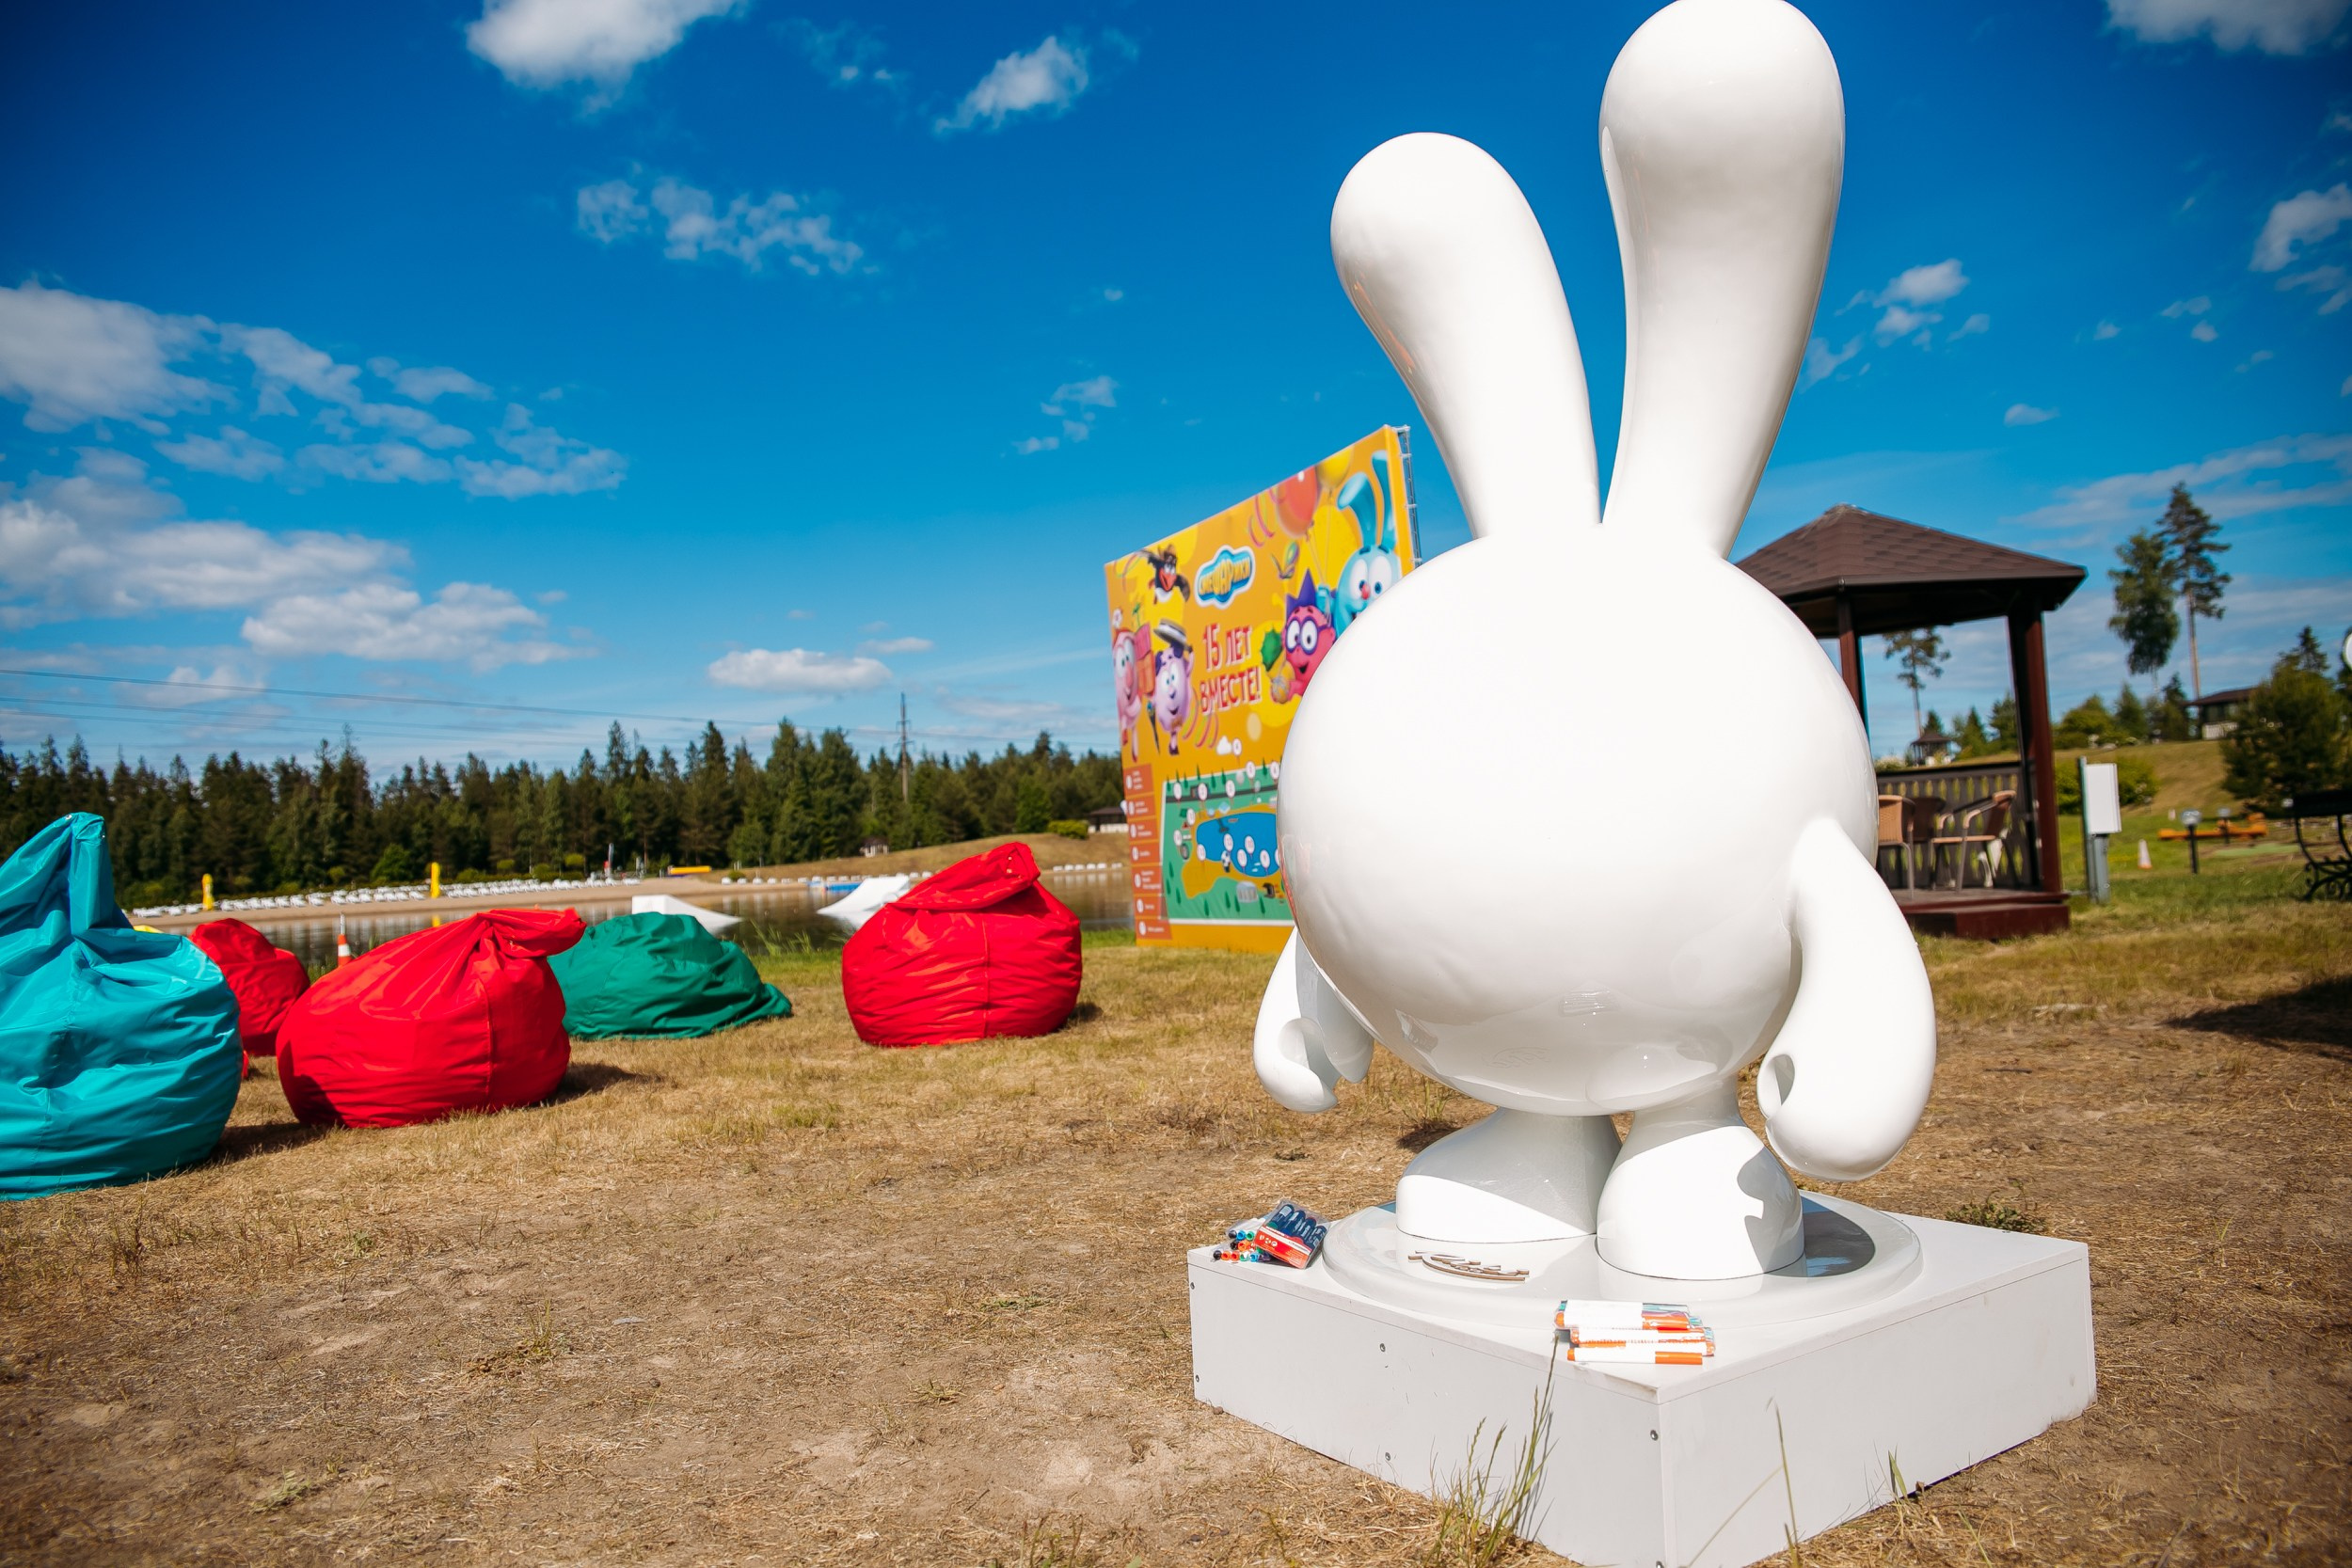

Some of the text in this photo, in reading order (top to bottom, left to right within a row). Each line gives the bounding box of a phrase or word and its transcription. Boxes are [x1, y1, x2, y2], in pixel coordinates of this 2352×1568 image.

[1203, 623, 1251, 672] 15 ЛЕТ
[1200, 667, 1262, 716] ВМЕСТЕ!
